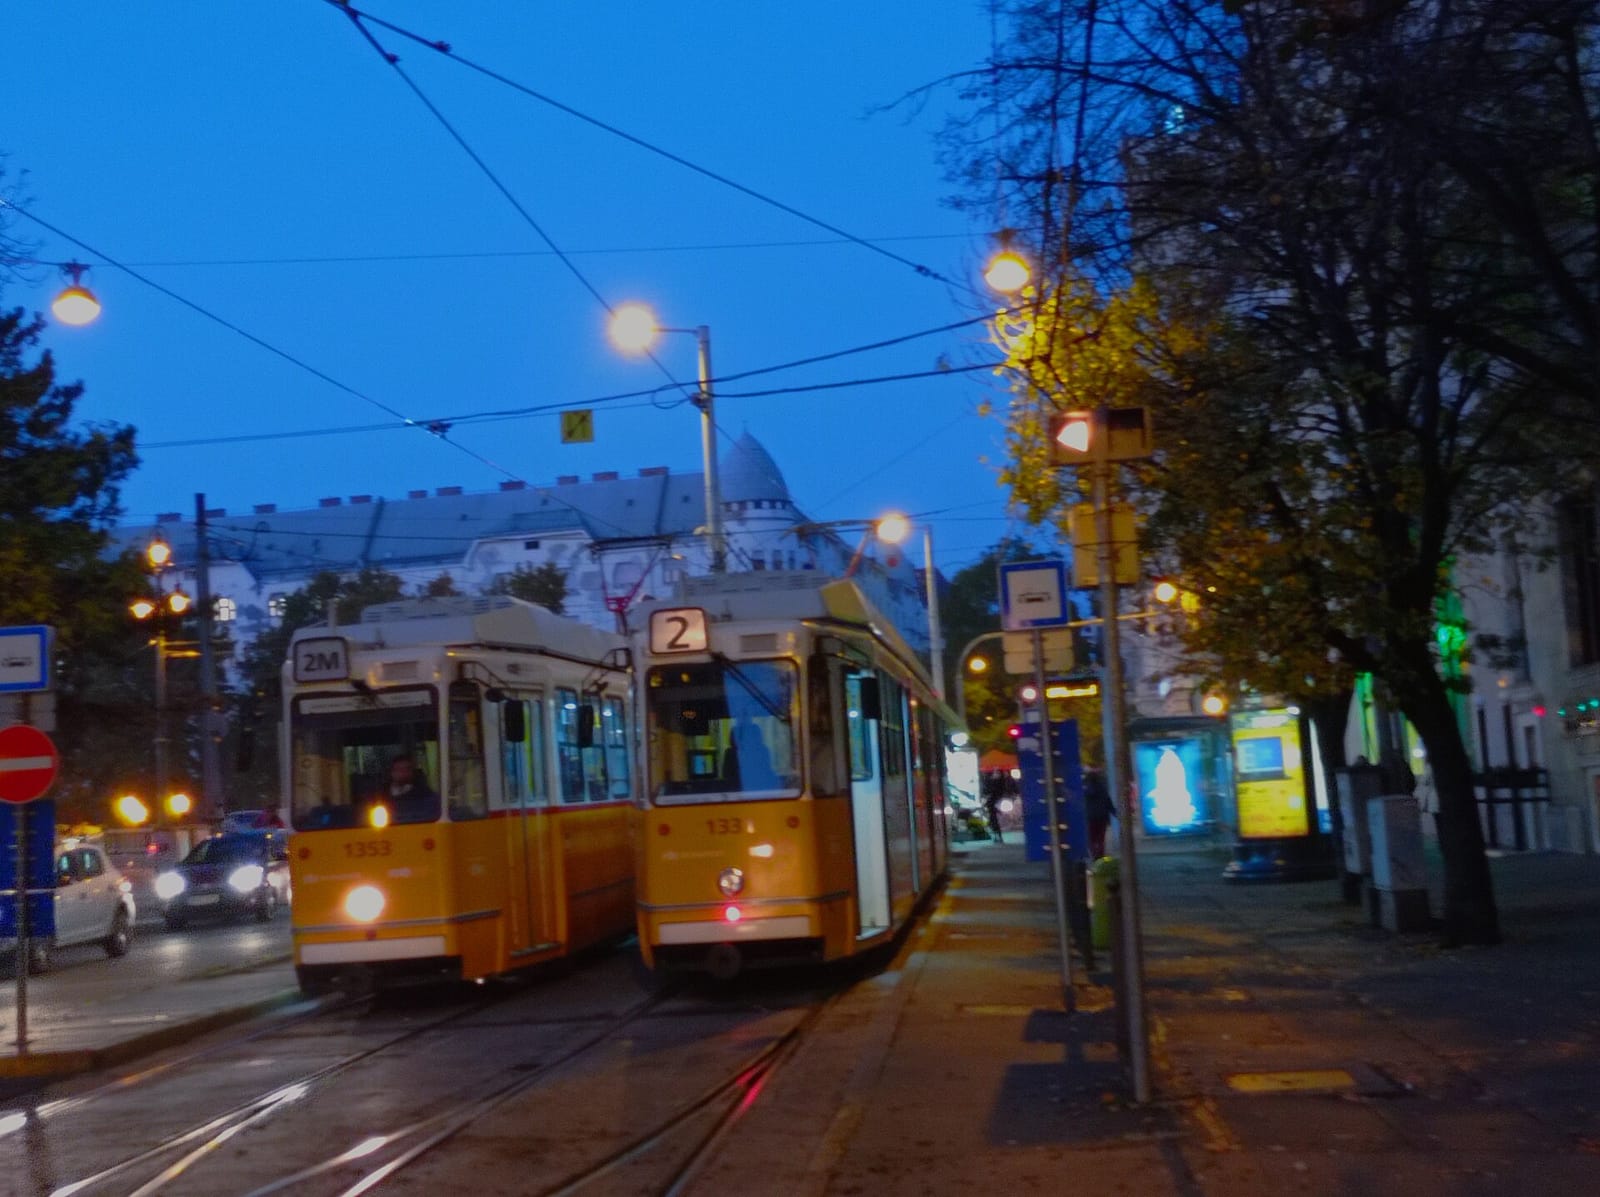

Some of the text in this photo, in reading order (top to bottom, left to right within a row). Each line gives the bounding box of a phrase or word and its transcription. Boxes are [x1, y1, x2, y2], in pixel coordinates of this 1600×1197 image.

[666, 616, 690, 649] 2
[303, 652, 339, 672] 2M
[344, 840, 392, 858] 1353
